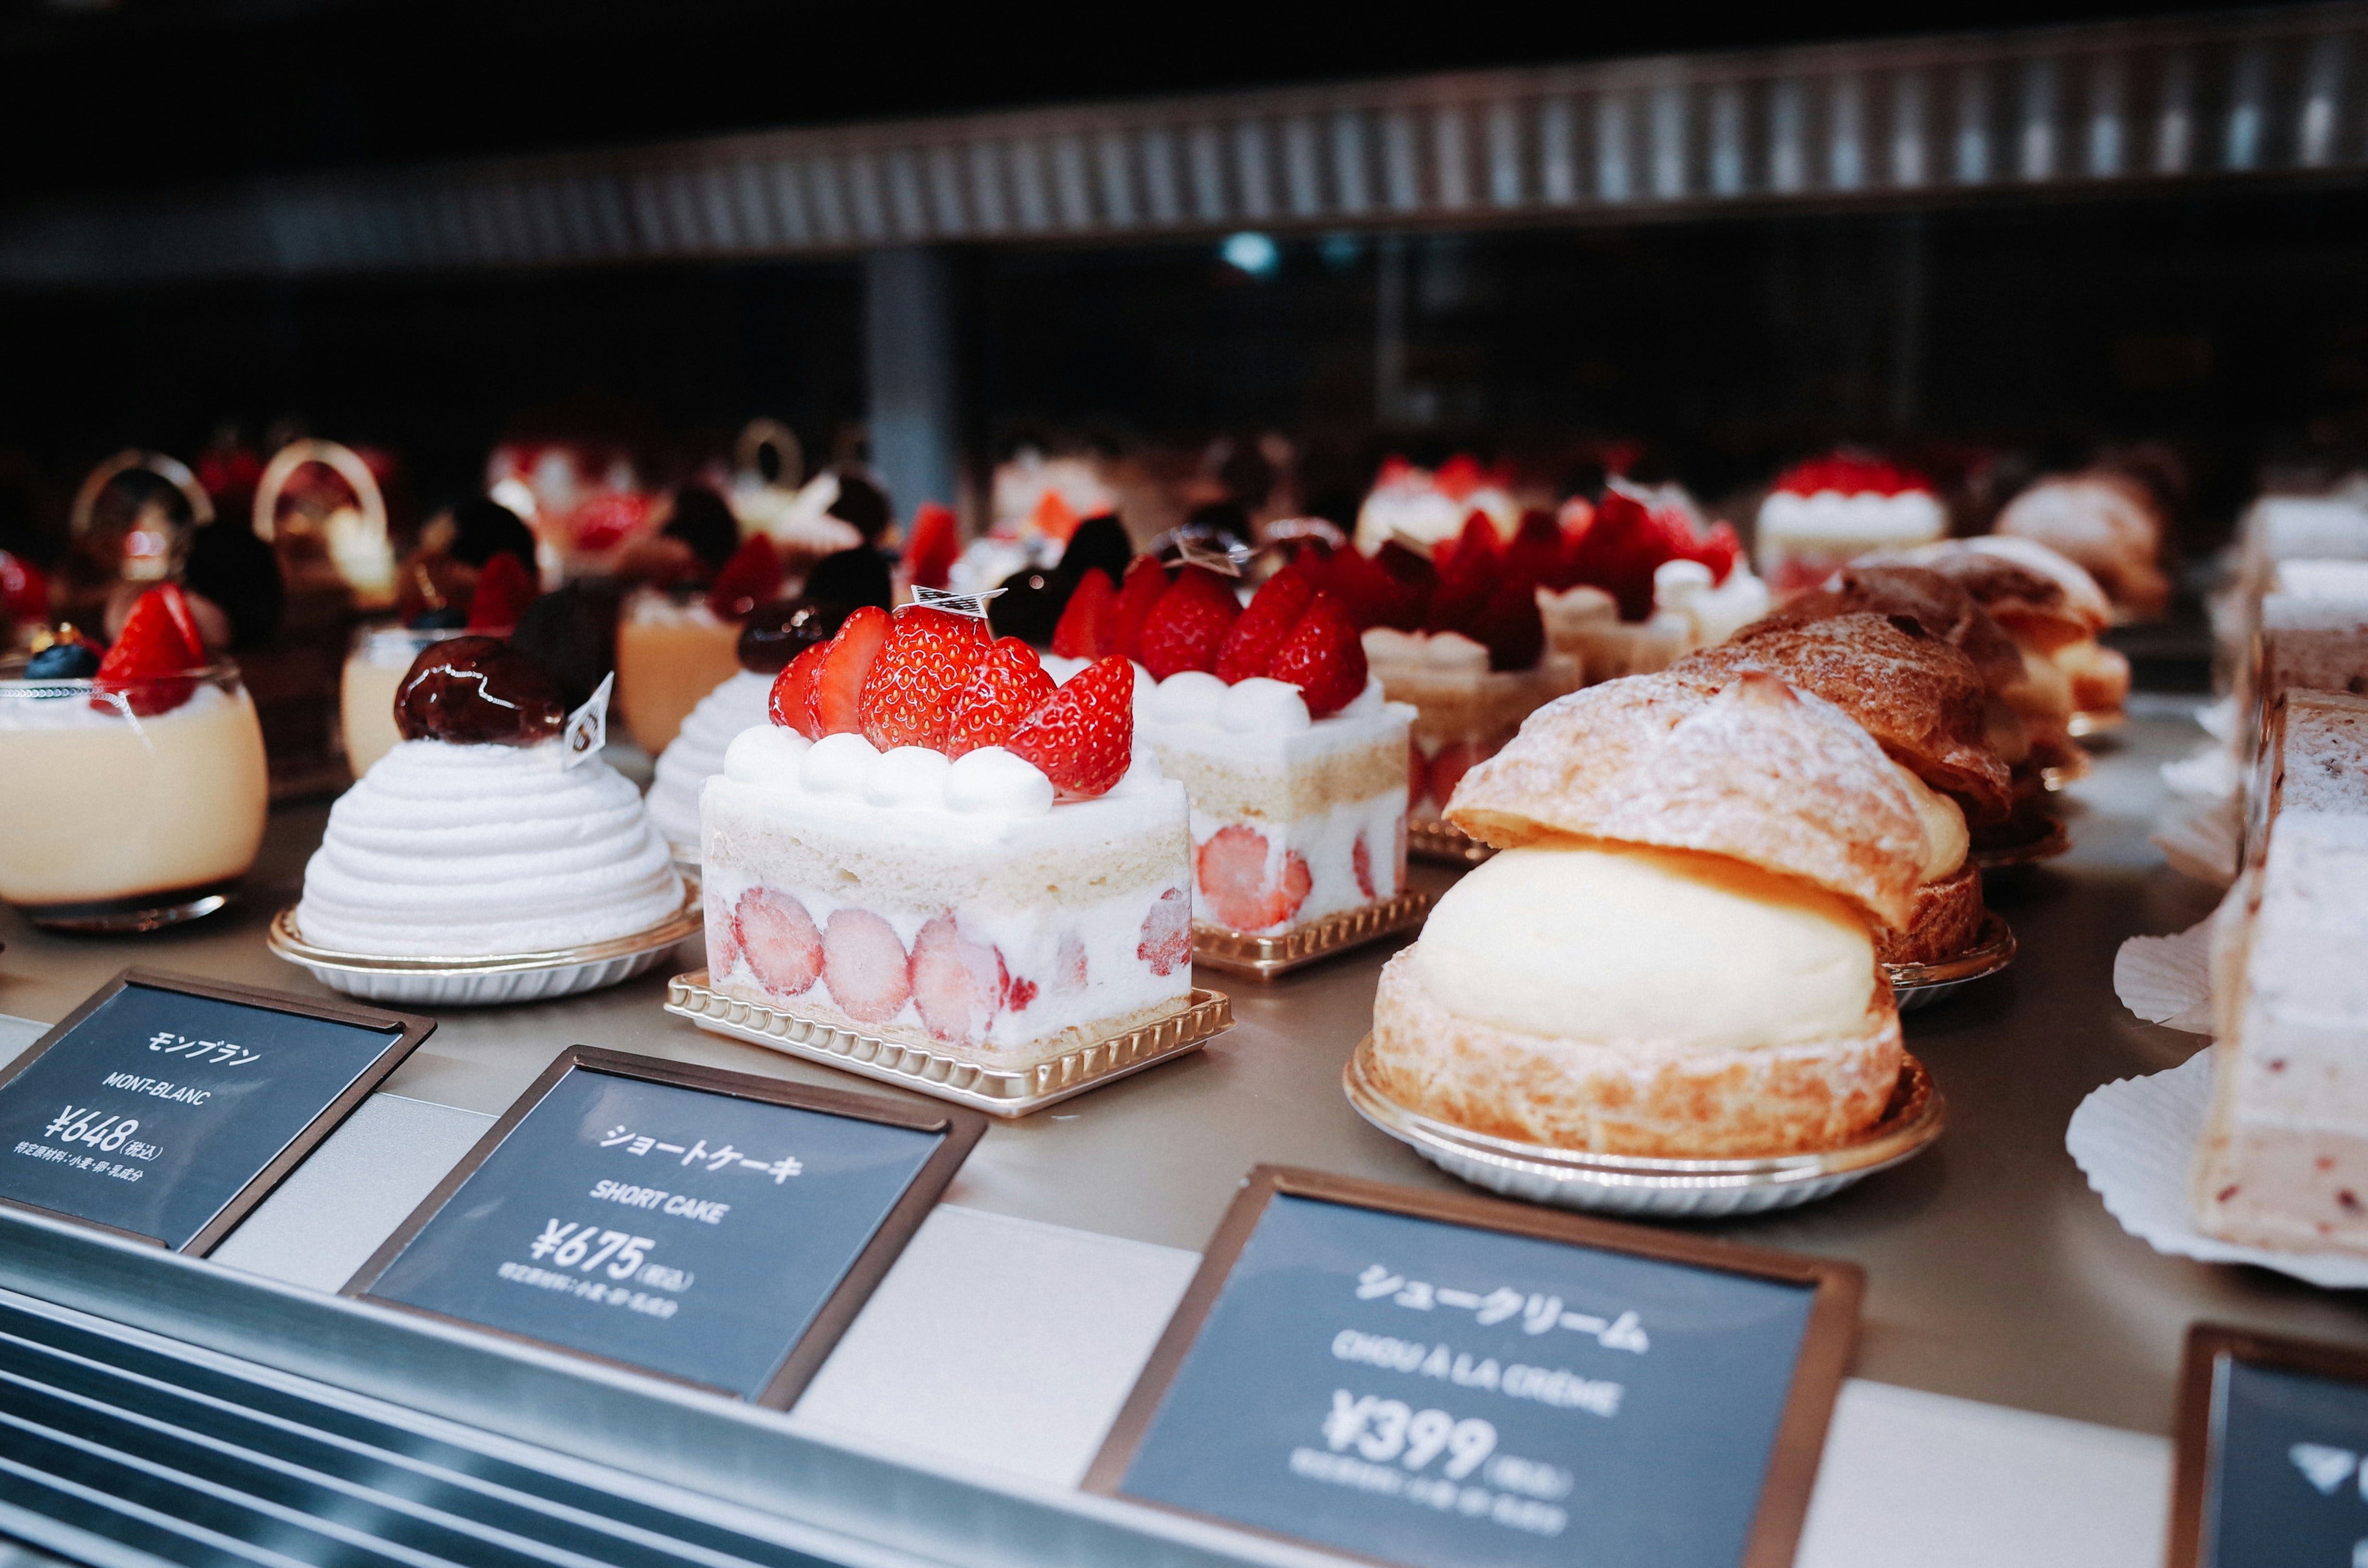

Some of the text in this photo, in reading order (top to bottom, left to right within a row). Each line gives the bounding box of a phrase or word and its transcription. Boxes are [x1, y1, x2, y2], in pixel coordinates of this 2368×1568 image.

[149, 1032, 261, 1066] モンブラン
[102, 1072, 211, 1106] MONT-BLANC
[600, 1124, 804, 1184] ショートケーキ
[589, 1179, 730, 1224] SHORT CAKE
[1356, 1263, 1650, 1353] シュークリーム
